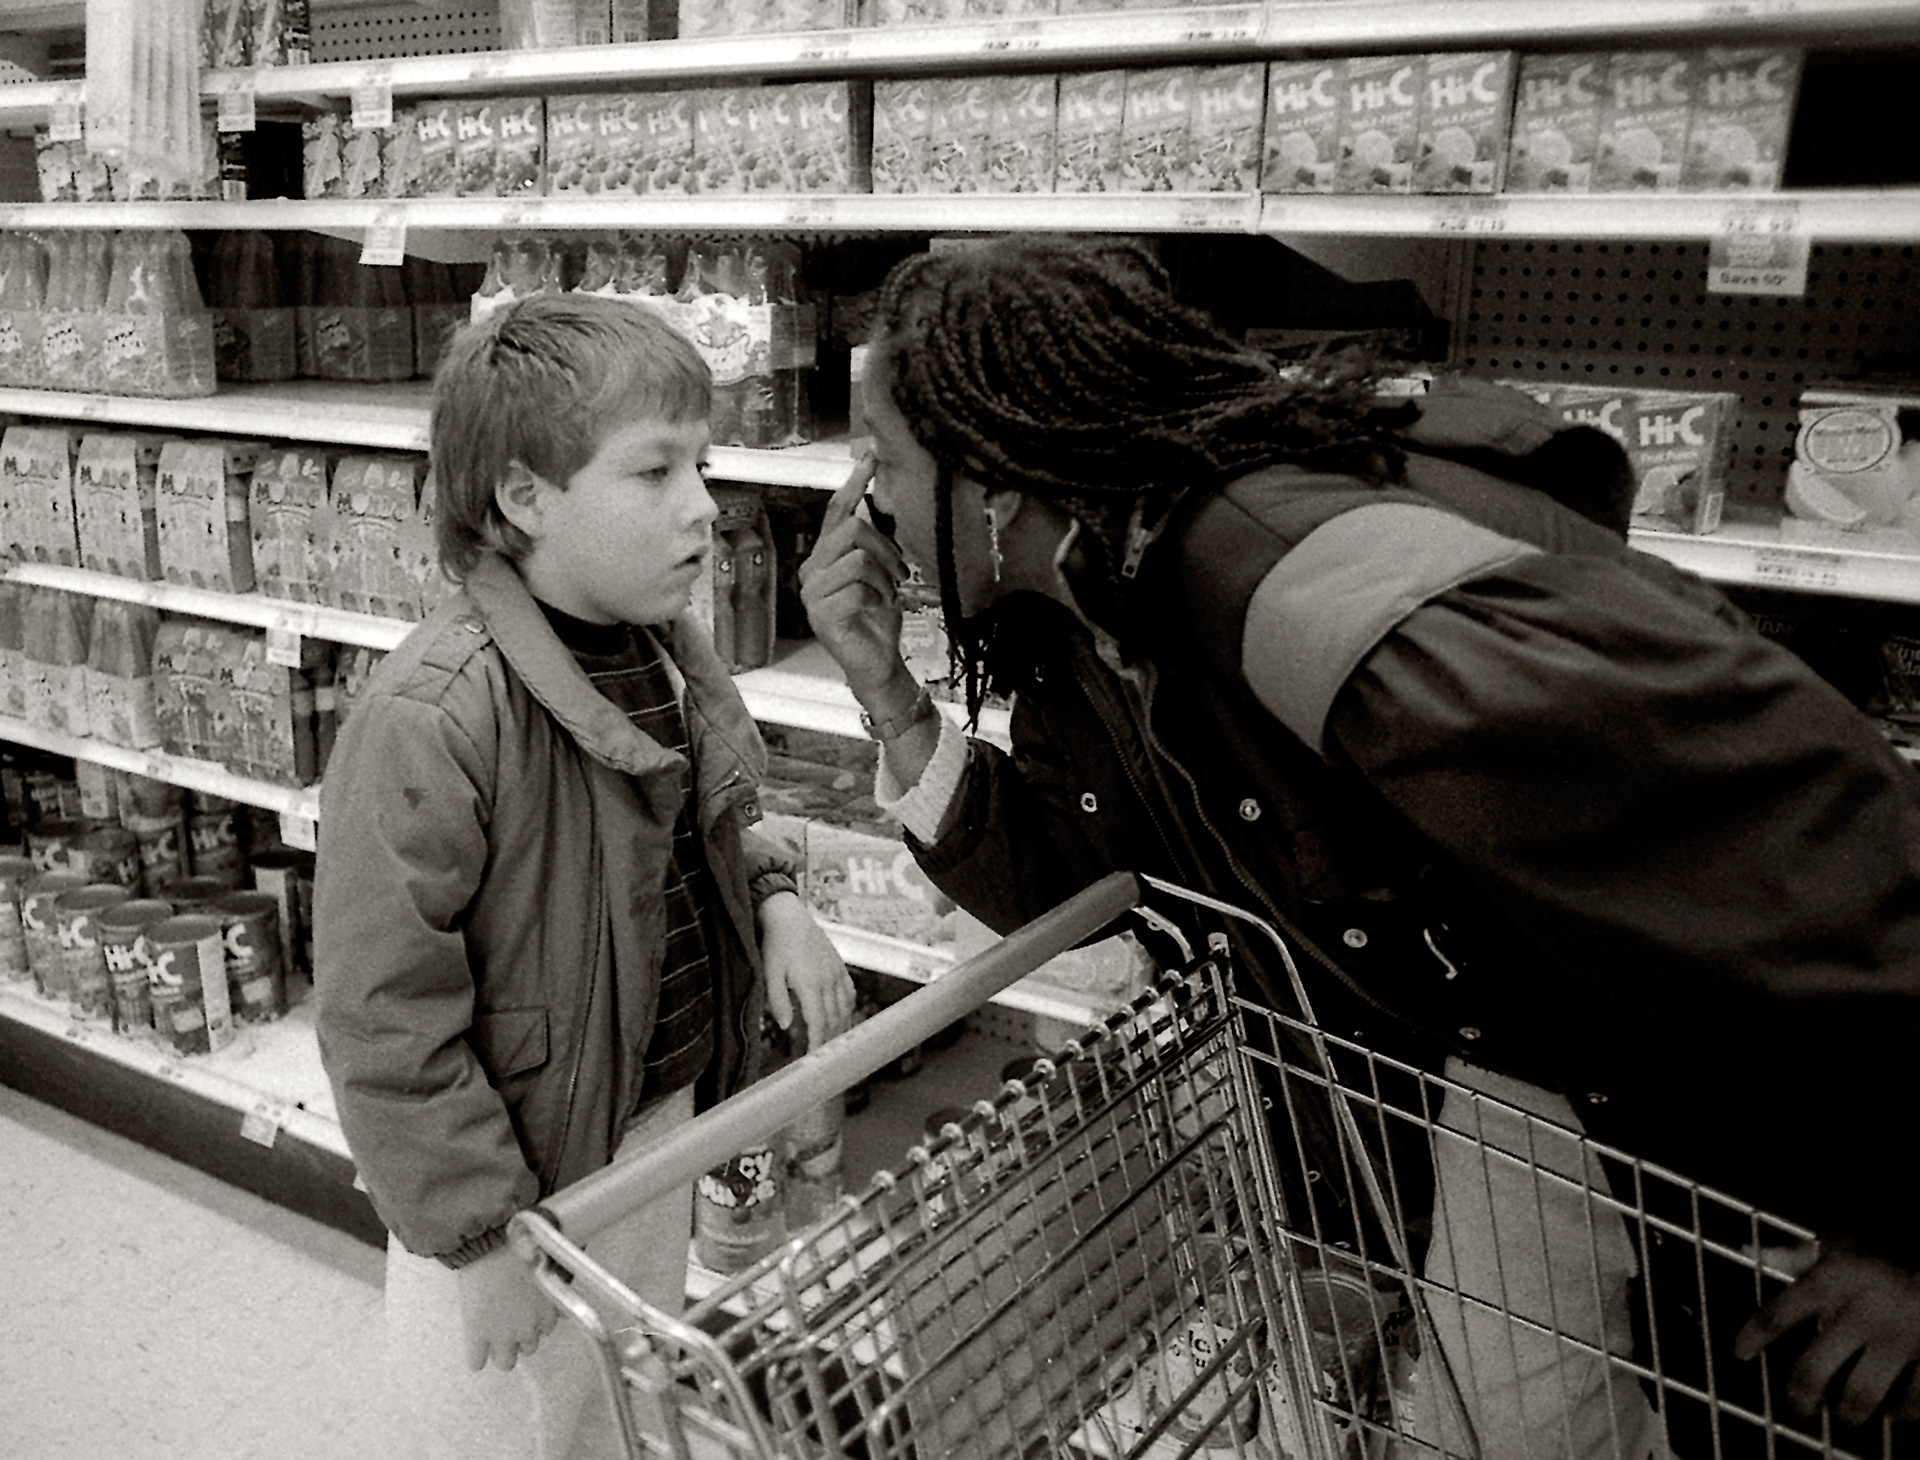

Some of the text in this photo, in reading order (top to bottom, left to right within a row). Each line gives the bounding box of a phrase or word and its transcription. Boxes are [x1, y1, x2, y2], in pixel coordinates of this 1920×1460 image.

[1275, 70, 1335, 113] Hi-C
[1351, 66, 1413, 112] Hi-C
[1430, 62, 1496, 108] Hi-C
[1526, 63, 1595, 111] Hi-C
[1615, 62, 1688, 108] Hi-C
[1708, 57, 1784, 104] Hi-C
[1640, 405, 1704, 446] Hi-C
[847, 851, 924, 901] Hi-C
